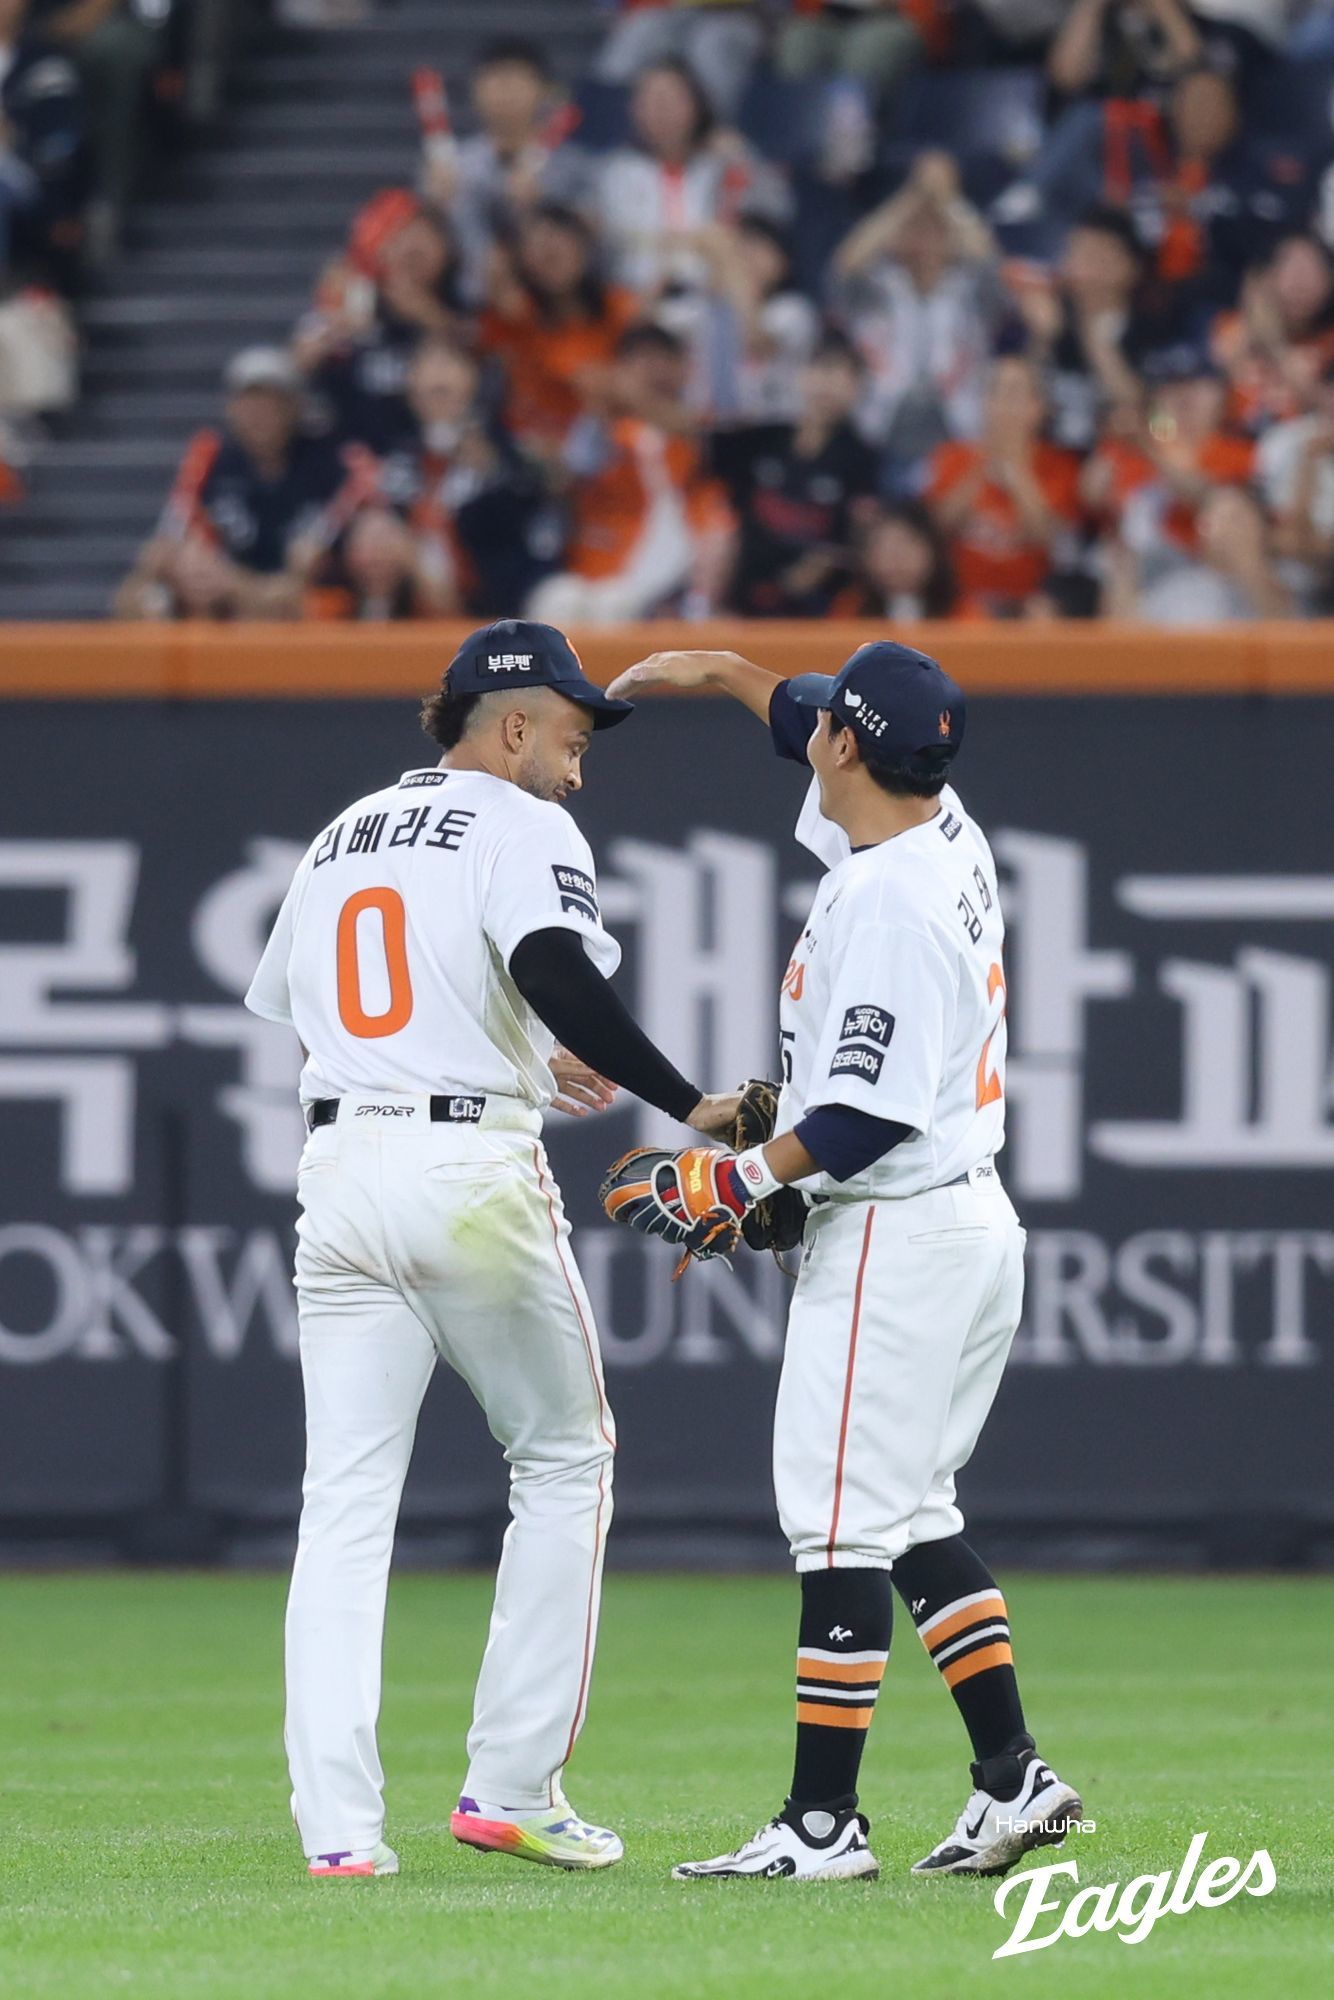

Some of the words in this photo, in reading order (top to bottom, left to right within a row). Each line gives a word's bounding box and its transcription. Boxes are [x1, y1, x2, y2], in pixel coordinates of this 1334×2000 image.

[487, 654, 532, 673] 부루펜
[855, 710, 883, 737] PLUS
[861, 702, 889, 730] LIFE
[313, 805, 476, 870] 리베라토
[557, 871, 597, 899] 한화오
[335, 886, 414, 1040] 0
[844, 1014, 888, 1041] 뉴케어
[975, 962, 1007, 1113] 2
[354, 1105, 415, 1118] SPYDER
